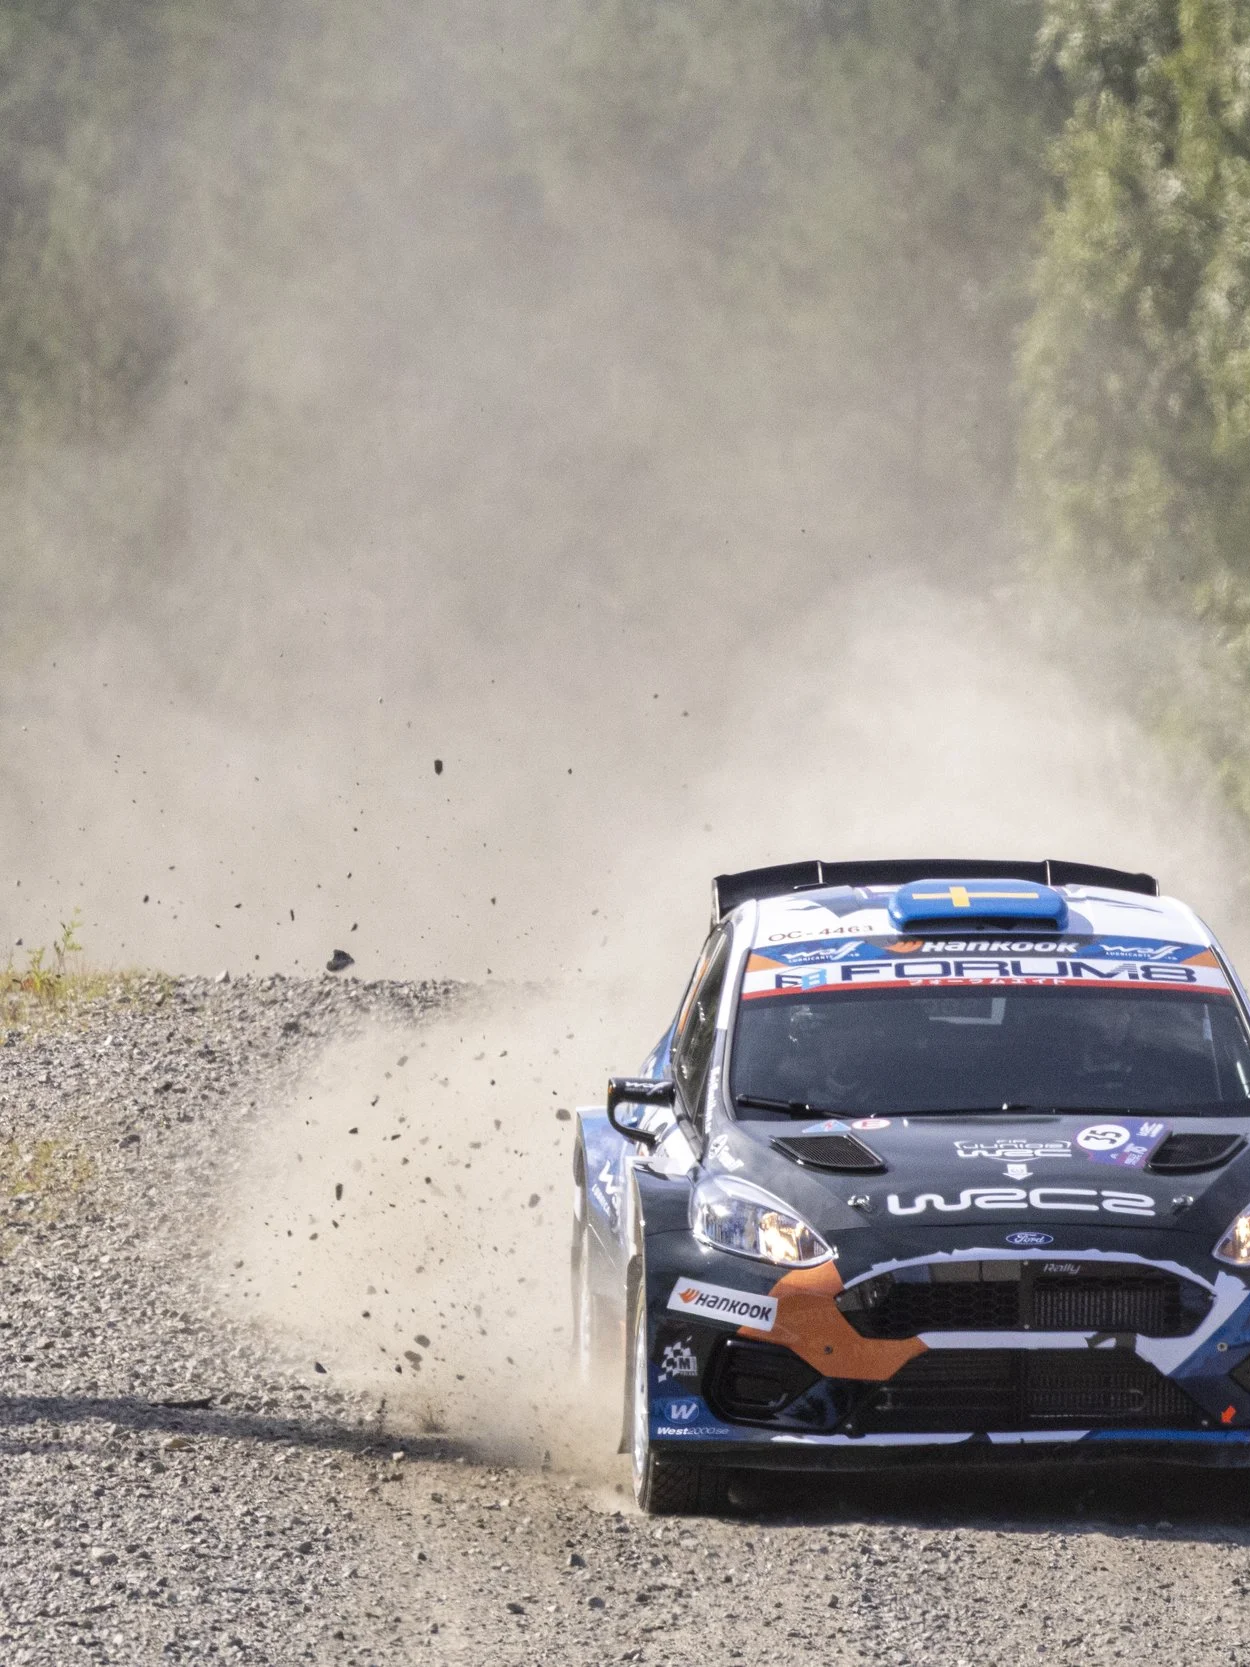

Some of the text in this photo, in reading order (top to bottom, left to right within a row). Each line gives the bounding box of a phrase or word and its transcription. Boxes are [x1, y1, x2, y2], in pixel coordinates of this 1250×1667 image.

[841, 960, 1197, 983] FORUM8
[1082, 1128, 1123, 1148] 35
[957, 1149, 1073, 1158] WRC
[888, 1187, 1157, 1217] WRC2
[1043, 1263, 1081, 1275] Rally
[671, 1402, 698, 1420] W
